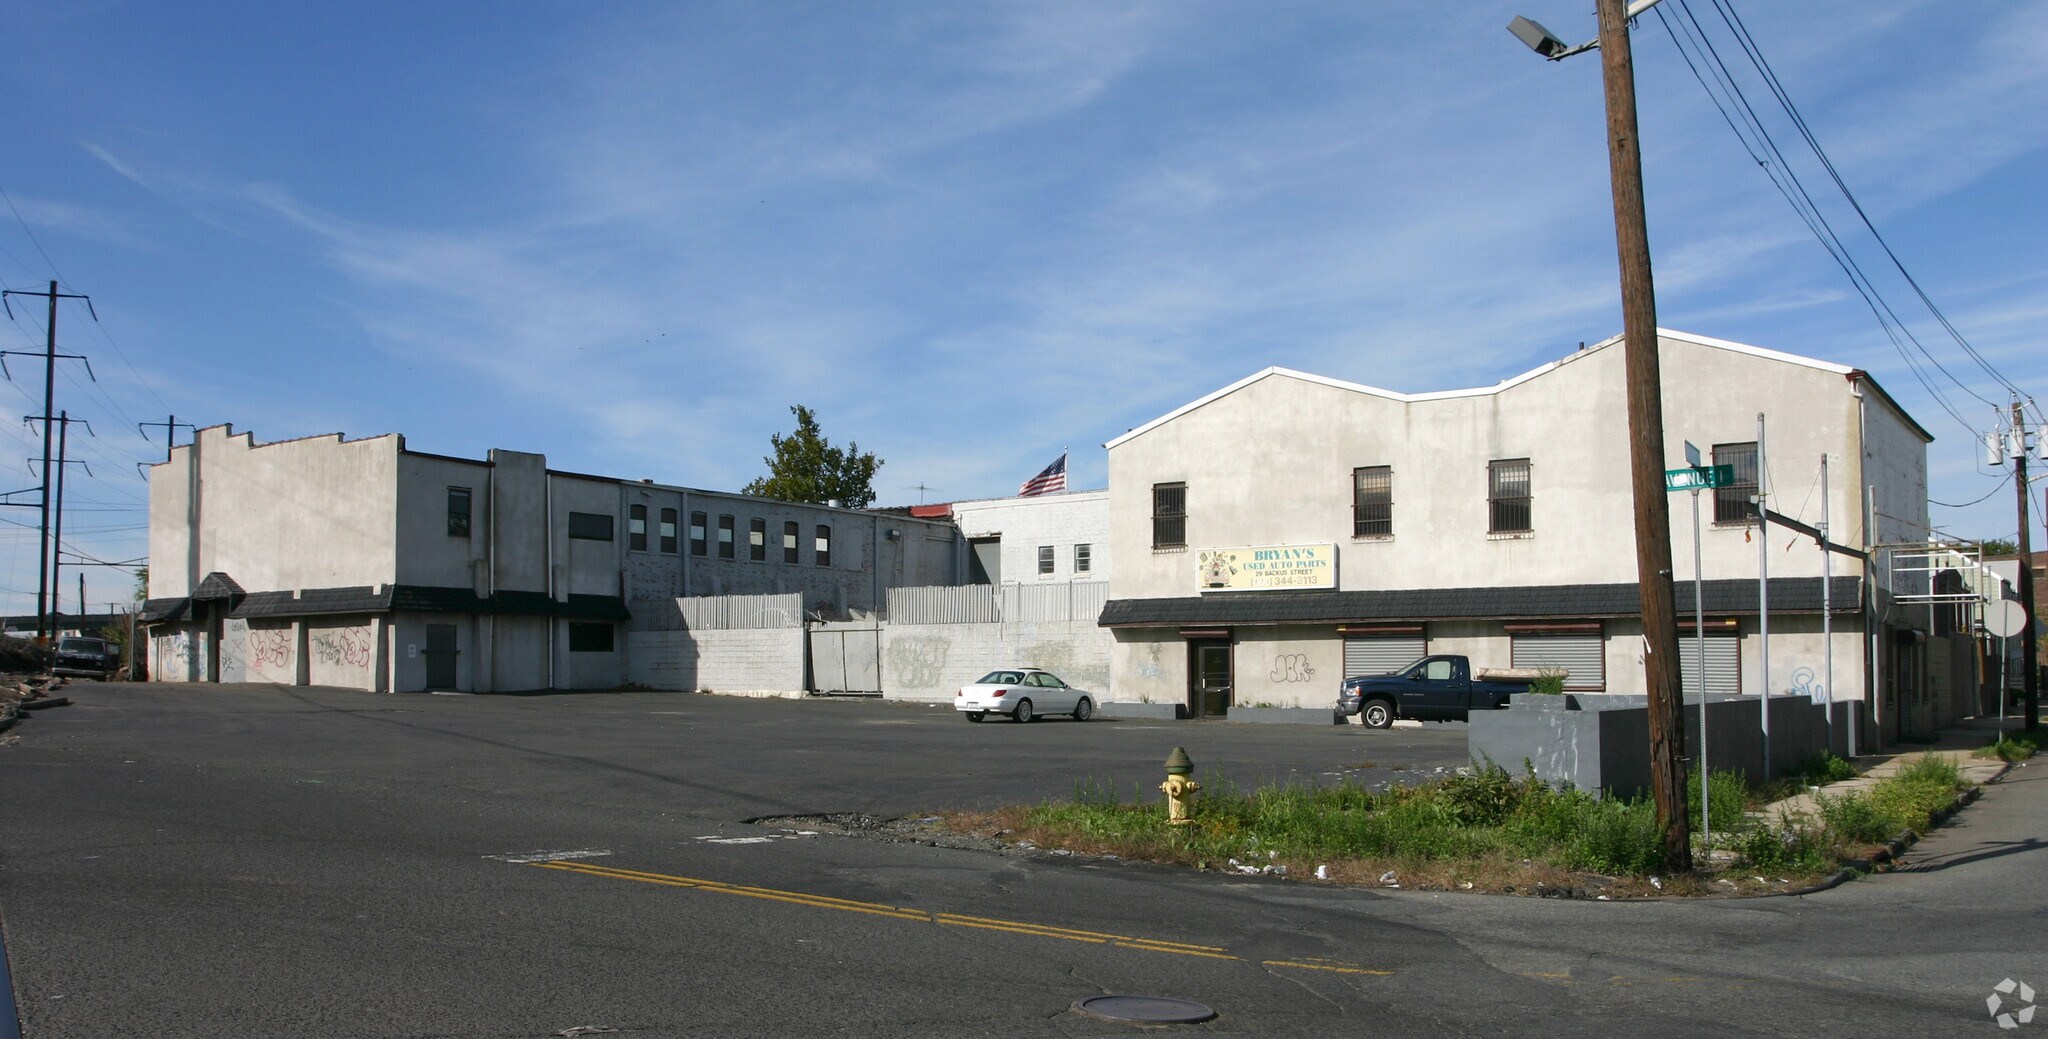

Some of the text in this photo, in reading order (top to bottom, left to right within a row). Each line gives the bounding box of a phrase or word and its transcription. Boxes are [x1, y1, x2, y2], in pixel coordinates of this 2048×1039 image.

[1254, 548, 1314, 560] BRYAN'S
[1270, 561, 1293, 569] AUTO
[1296, 560, 1326, 568] PARTS
[1275, 576, 1317, 585] 344-3113
